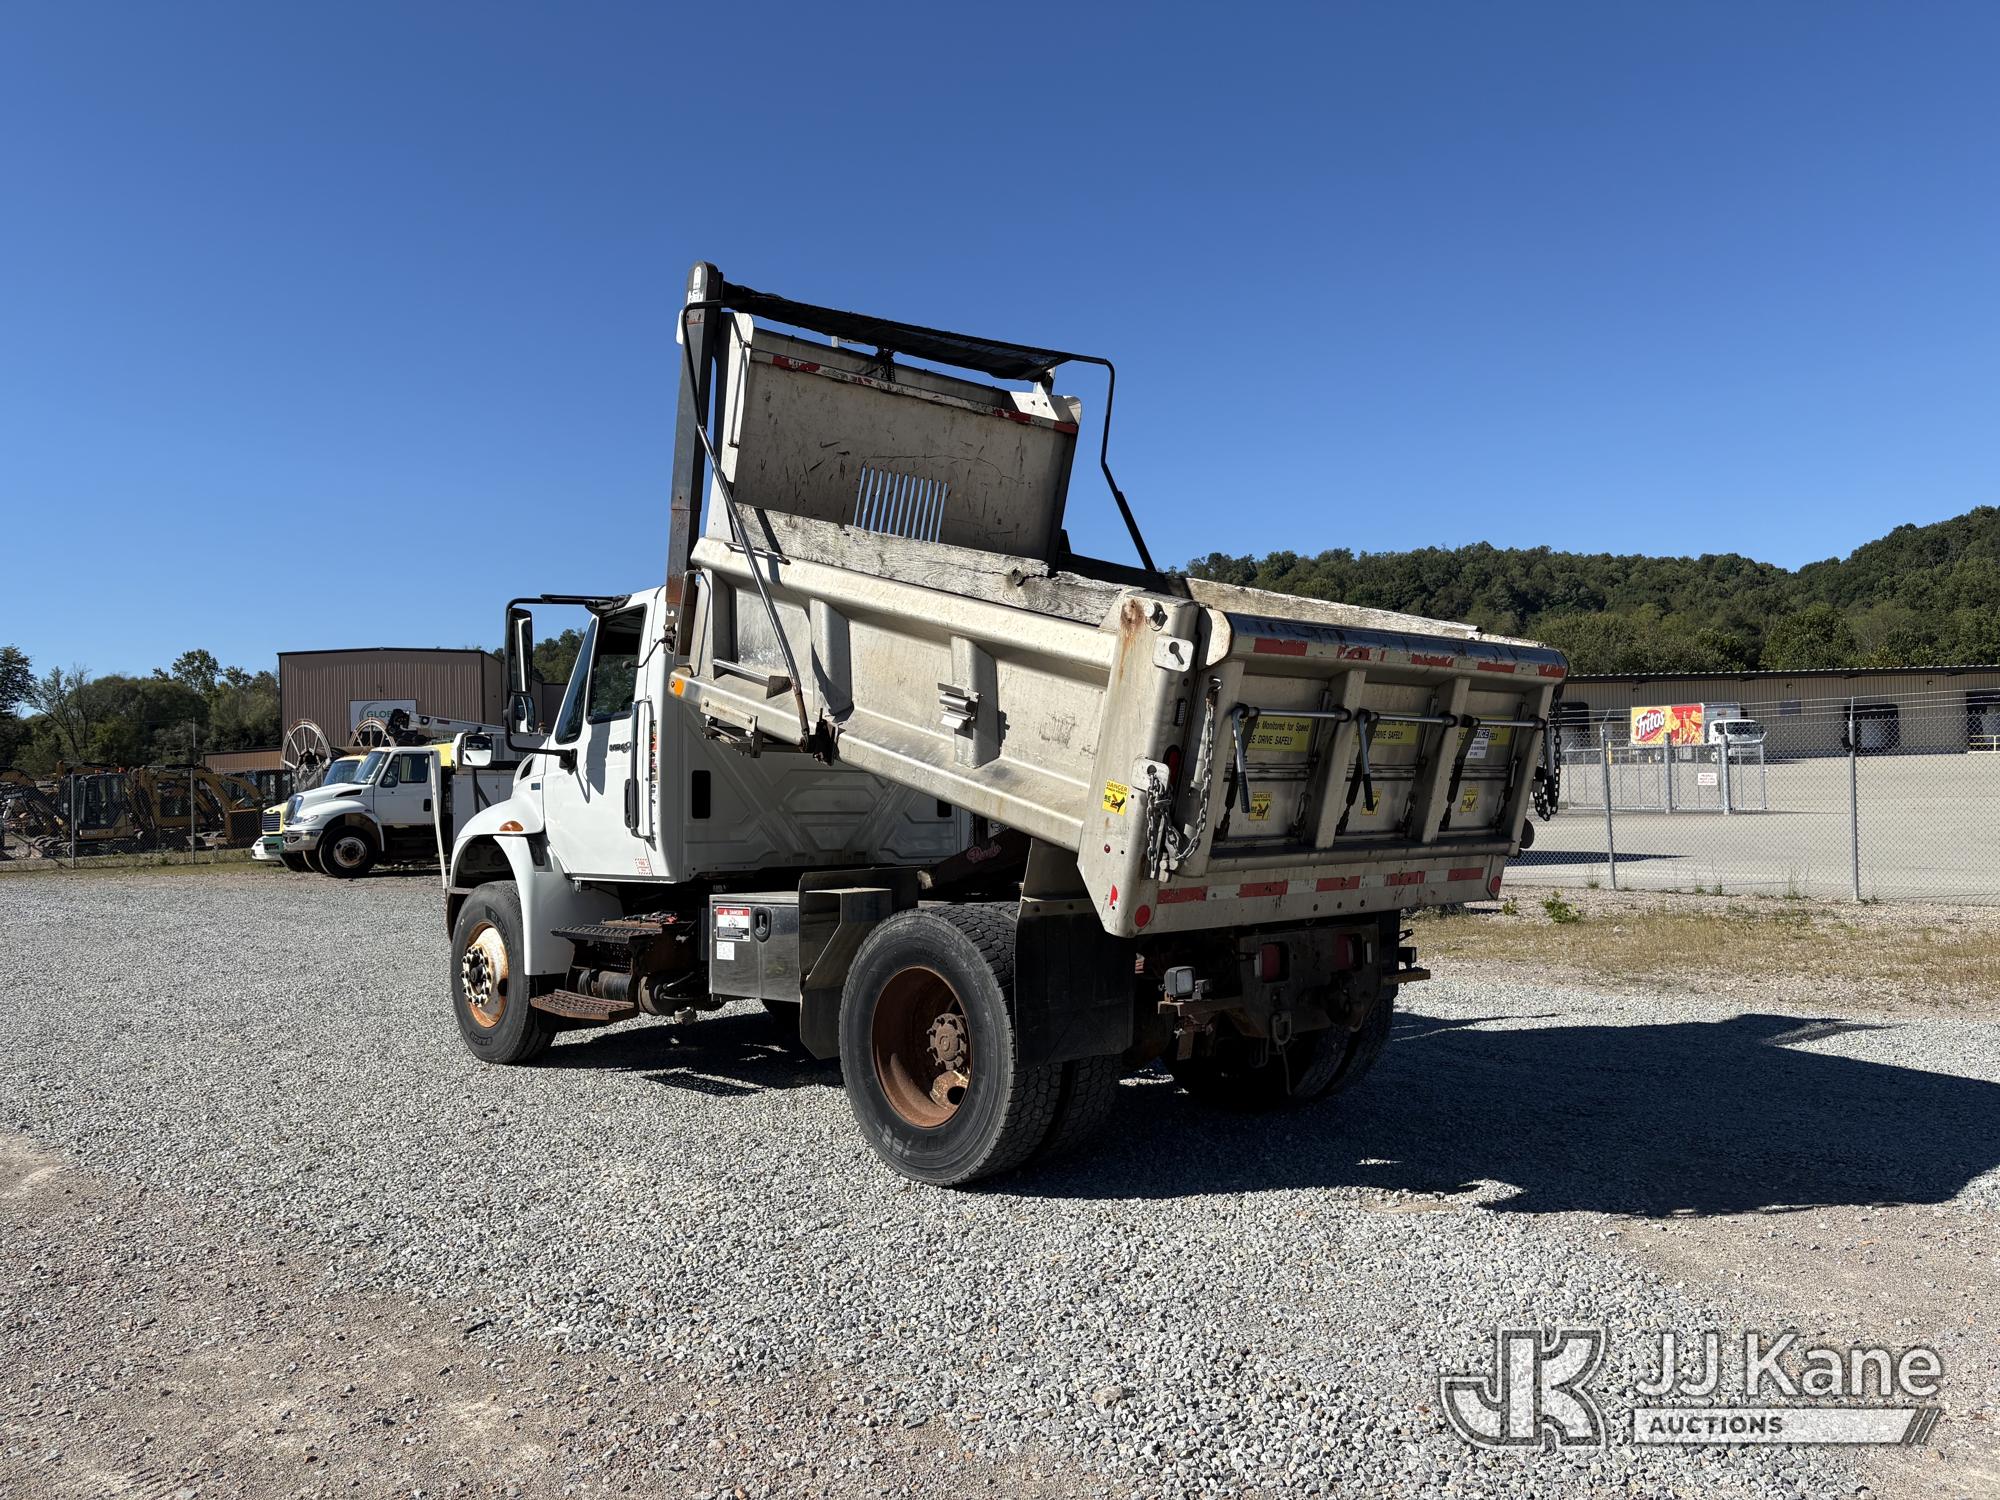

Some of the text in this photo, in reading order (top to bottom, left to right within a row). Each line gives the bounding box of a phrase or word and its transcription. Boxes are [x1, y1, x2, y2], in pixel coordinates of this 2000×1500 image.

[1262, 721, 1286, 731] Monitored
[1287, 722, 1295, 731] for
[1295, 722, 1310, 734] Speed
[1635, 711, 1665, 737] Fritos
[1257, 734, 1273, 745] DRIVE
[1274, 735, 1294, 746] SAFELY
[1106, 782, 1127, 792] DANGER
